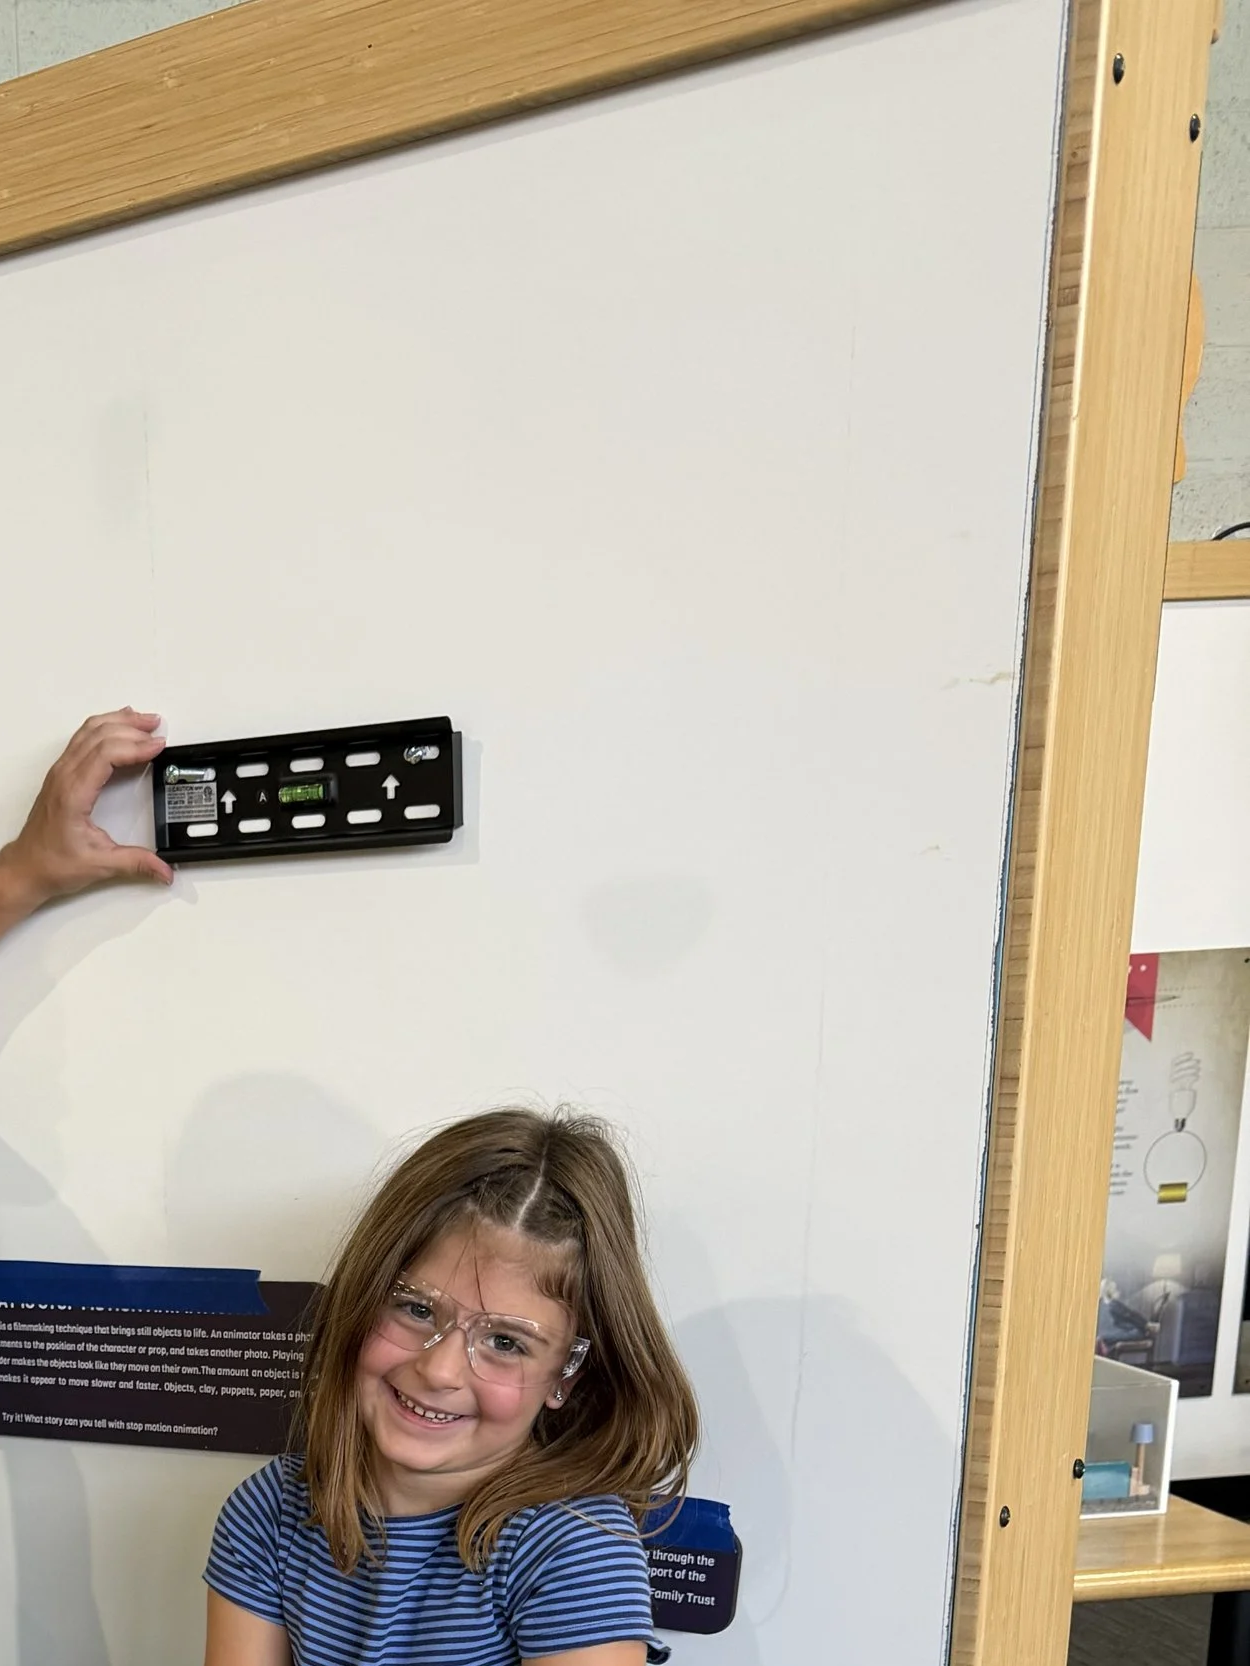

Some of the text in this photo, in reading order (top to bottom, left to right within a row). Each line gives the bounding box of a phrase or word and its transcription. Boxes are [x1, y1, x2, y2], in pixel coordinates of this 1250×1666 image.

[13, 1321, 54, 1334] filmmaking
[55, 1324, 92, 1334] technique
[93, 1325, 109, 1334] that
[110, 1325, 135, 1336] brings
[136, 1326, 151, 1335] still
[152, 1326, 182, 1338] objects
[193, 1328, 208, 1338] life.
[210, 1329, 221, 1338] An
[222, 1331, 260, 1339] animator
[262, 1330, 286, 1340] takes
[99, 1343, 303, 1362] character prop, and takes another photo. Playing
[91, 1378, 286, 1398] slower and faster. Objects, clay, puppets, paper,
[2, 1412, 13, 1422] Try
[24, 1413, 43, 1423] What
[44, 1416, 63, 1426] story
[64, 1417, 78, 1425] can
[79, 1419, 92, 1428] you
[94, 1419, 106, 1427] tell
[107, 1419, 124, 1429] with
[126, 1421, 143, 1432] stop
[144, 1422, 172, 1432] motion
[173, 1425, 218, 1435] animation?
[652, 1550, 694, 1565] through
[697, 1555, 715, 1566] the
[648, 1567, 706, 1582] port of the
[686, 1592, 715, 1606] Trust
